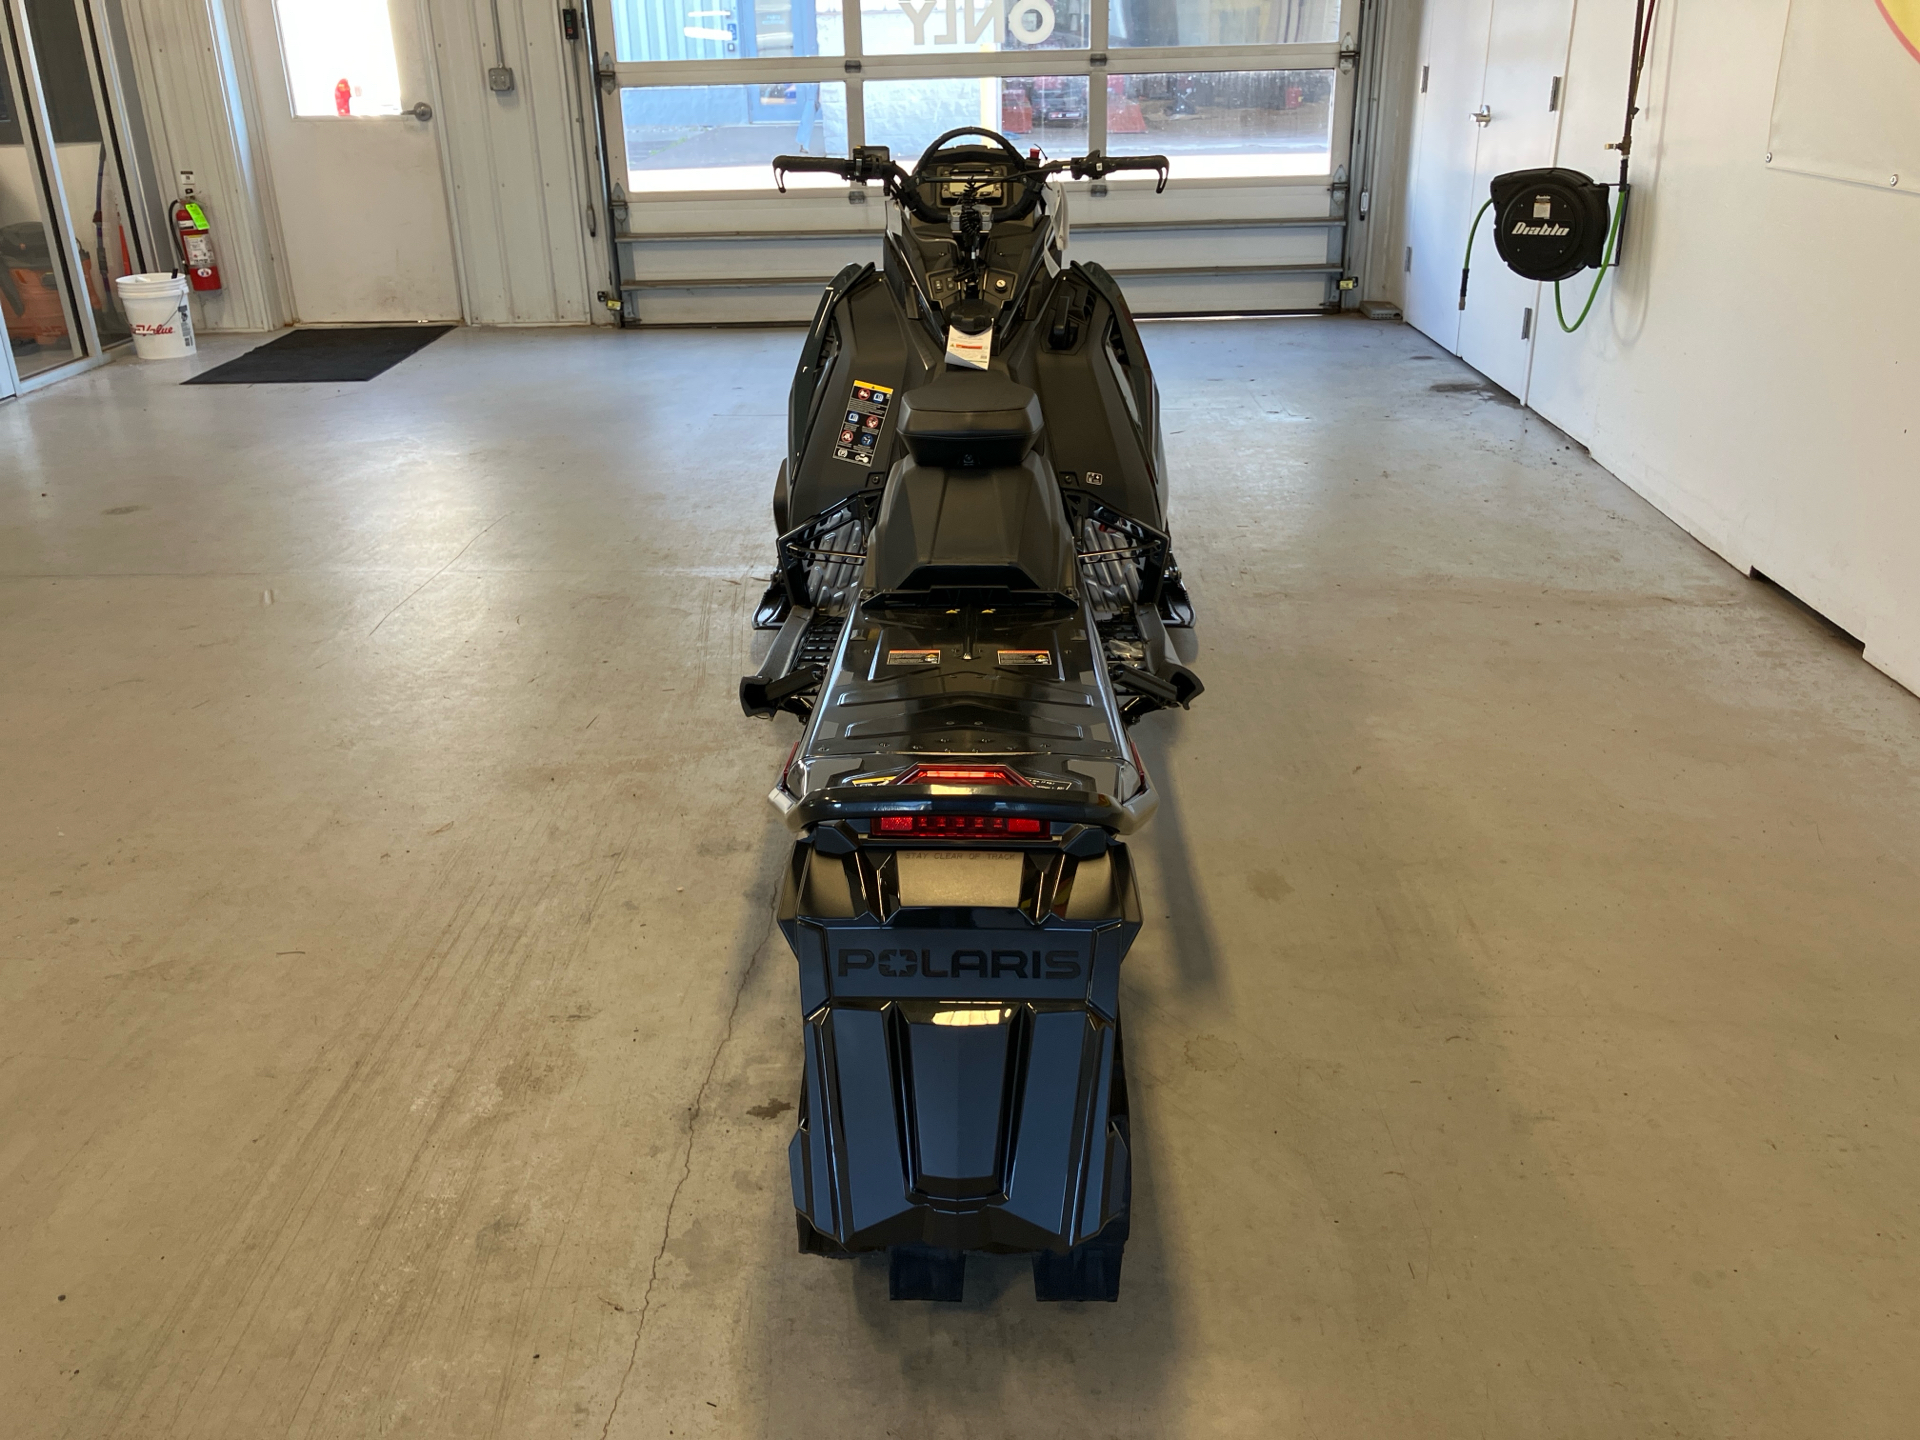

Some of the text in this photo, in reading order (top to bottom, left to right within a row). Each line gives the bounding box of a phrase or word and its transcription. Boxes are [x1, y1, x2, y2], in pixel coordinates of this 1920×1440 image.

[1511, 222, 1570, 236] Diablo
[934, 852, 963, 860] CLEAR
[968, 852, 981, 860] OF
[837, 949, 1082, 979] POLARIS
